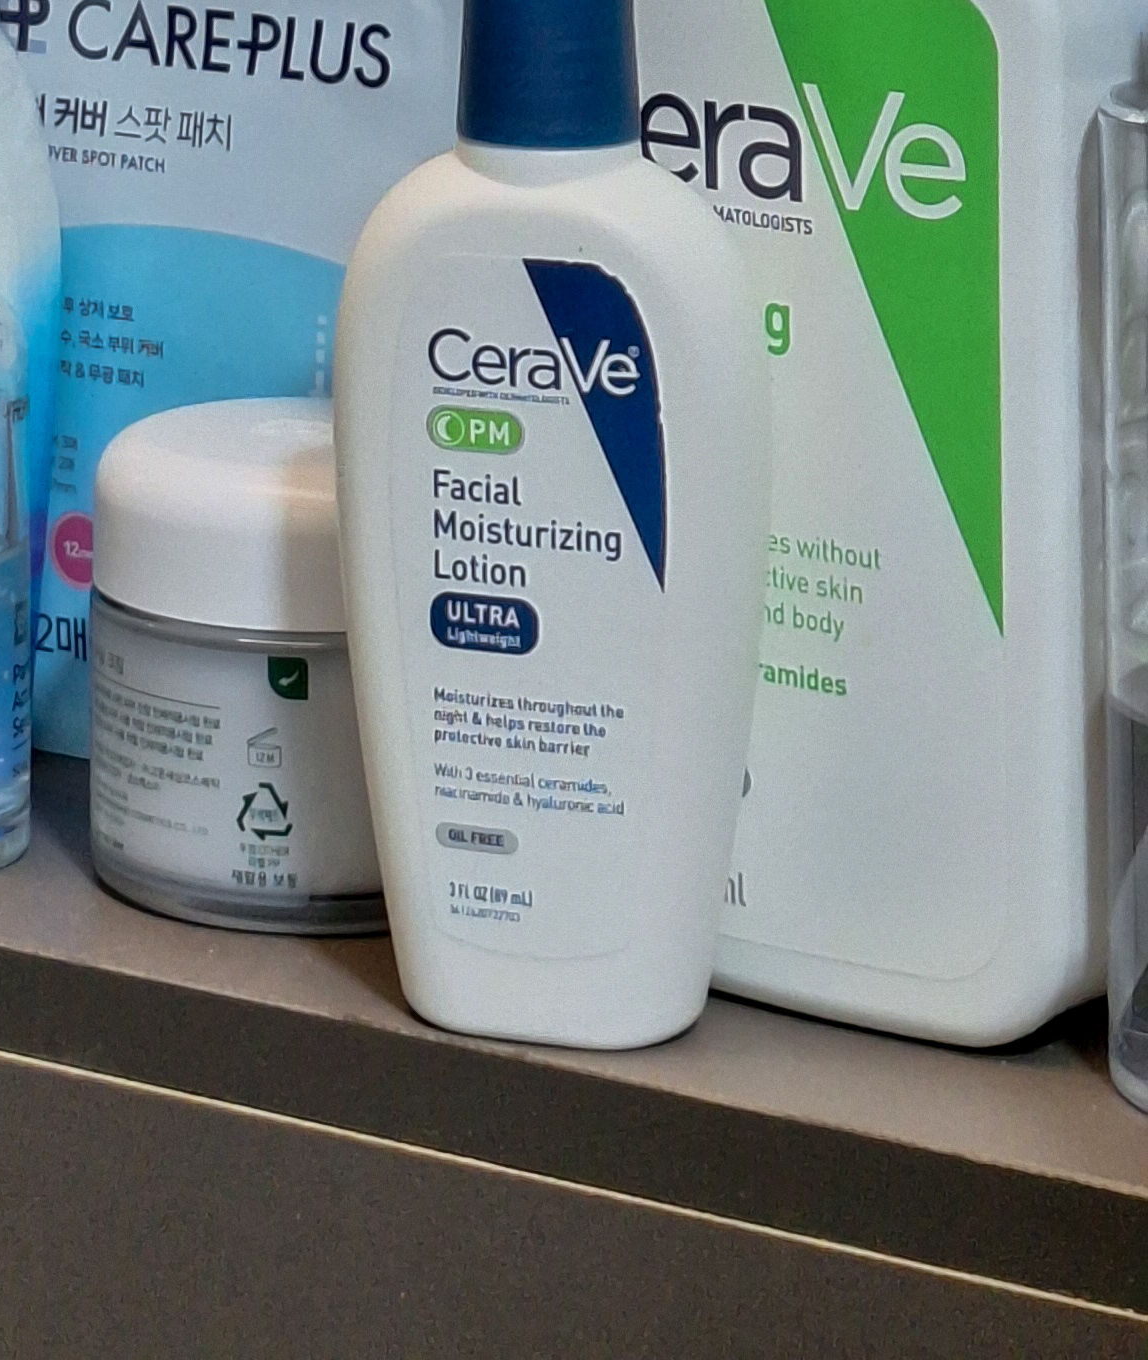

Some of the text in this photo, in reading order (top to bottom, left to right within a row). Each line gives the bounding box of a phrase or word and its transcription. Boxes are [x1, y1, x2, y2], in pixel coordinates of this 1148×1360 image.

[54, 97, 108, 138] 커버
[114, 105, 173, 144] 스팟
[176, 111, 232, 152] 패치
[82, 149, 116, 167] SPOT
[120, 153, 167, 173] PATCH
[640, 83, 966, 220] eraVe
[713, 205, 814, 236] MATOLOGISTS
[75, 362, 86, 379] &
[428, 328, 640, 397] CeraVe
[469, 418, 510, 447] PM
[433, 468, 522, 506] Facial
[434, 508, 622, 562] Moisturizing
[434, 548, 526, 588] Lotion
[796, 536, 882, 571] without
[816, 575, 863, 605] skin
[446, 599, 521, 629] ULTRA
[793, 605, 845, 643] body
[446, 627, 522, 649] Lightweight
[759, 662, 848, 697] amides
[433, 687, 625, 720] Moisturizes throughout the
[433, 708, 607, 738] night & helps restore the
[434, 728, 591, 758] protective skin barrier
[433, 763, 463, 780] With
[475, 770, 535, 790] essential
[434, 784, 625, 817] niacinamide & hyaluronic acid
[448, 828, 504, 848] OIL FREE
